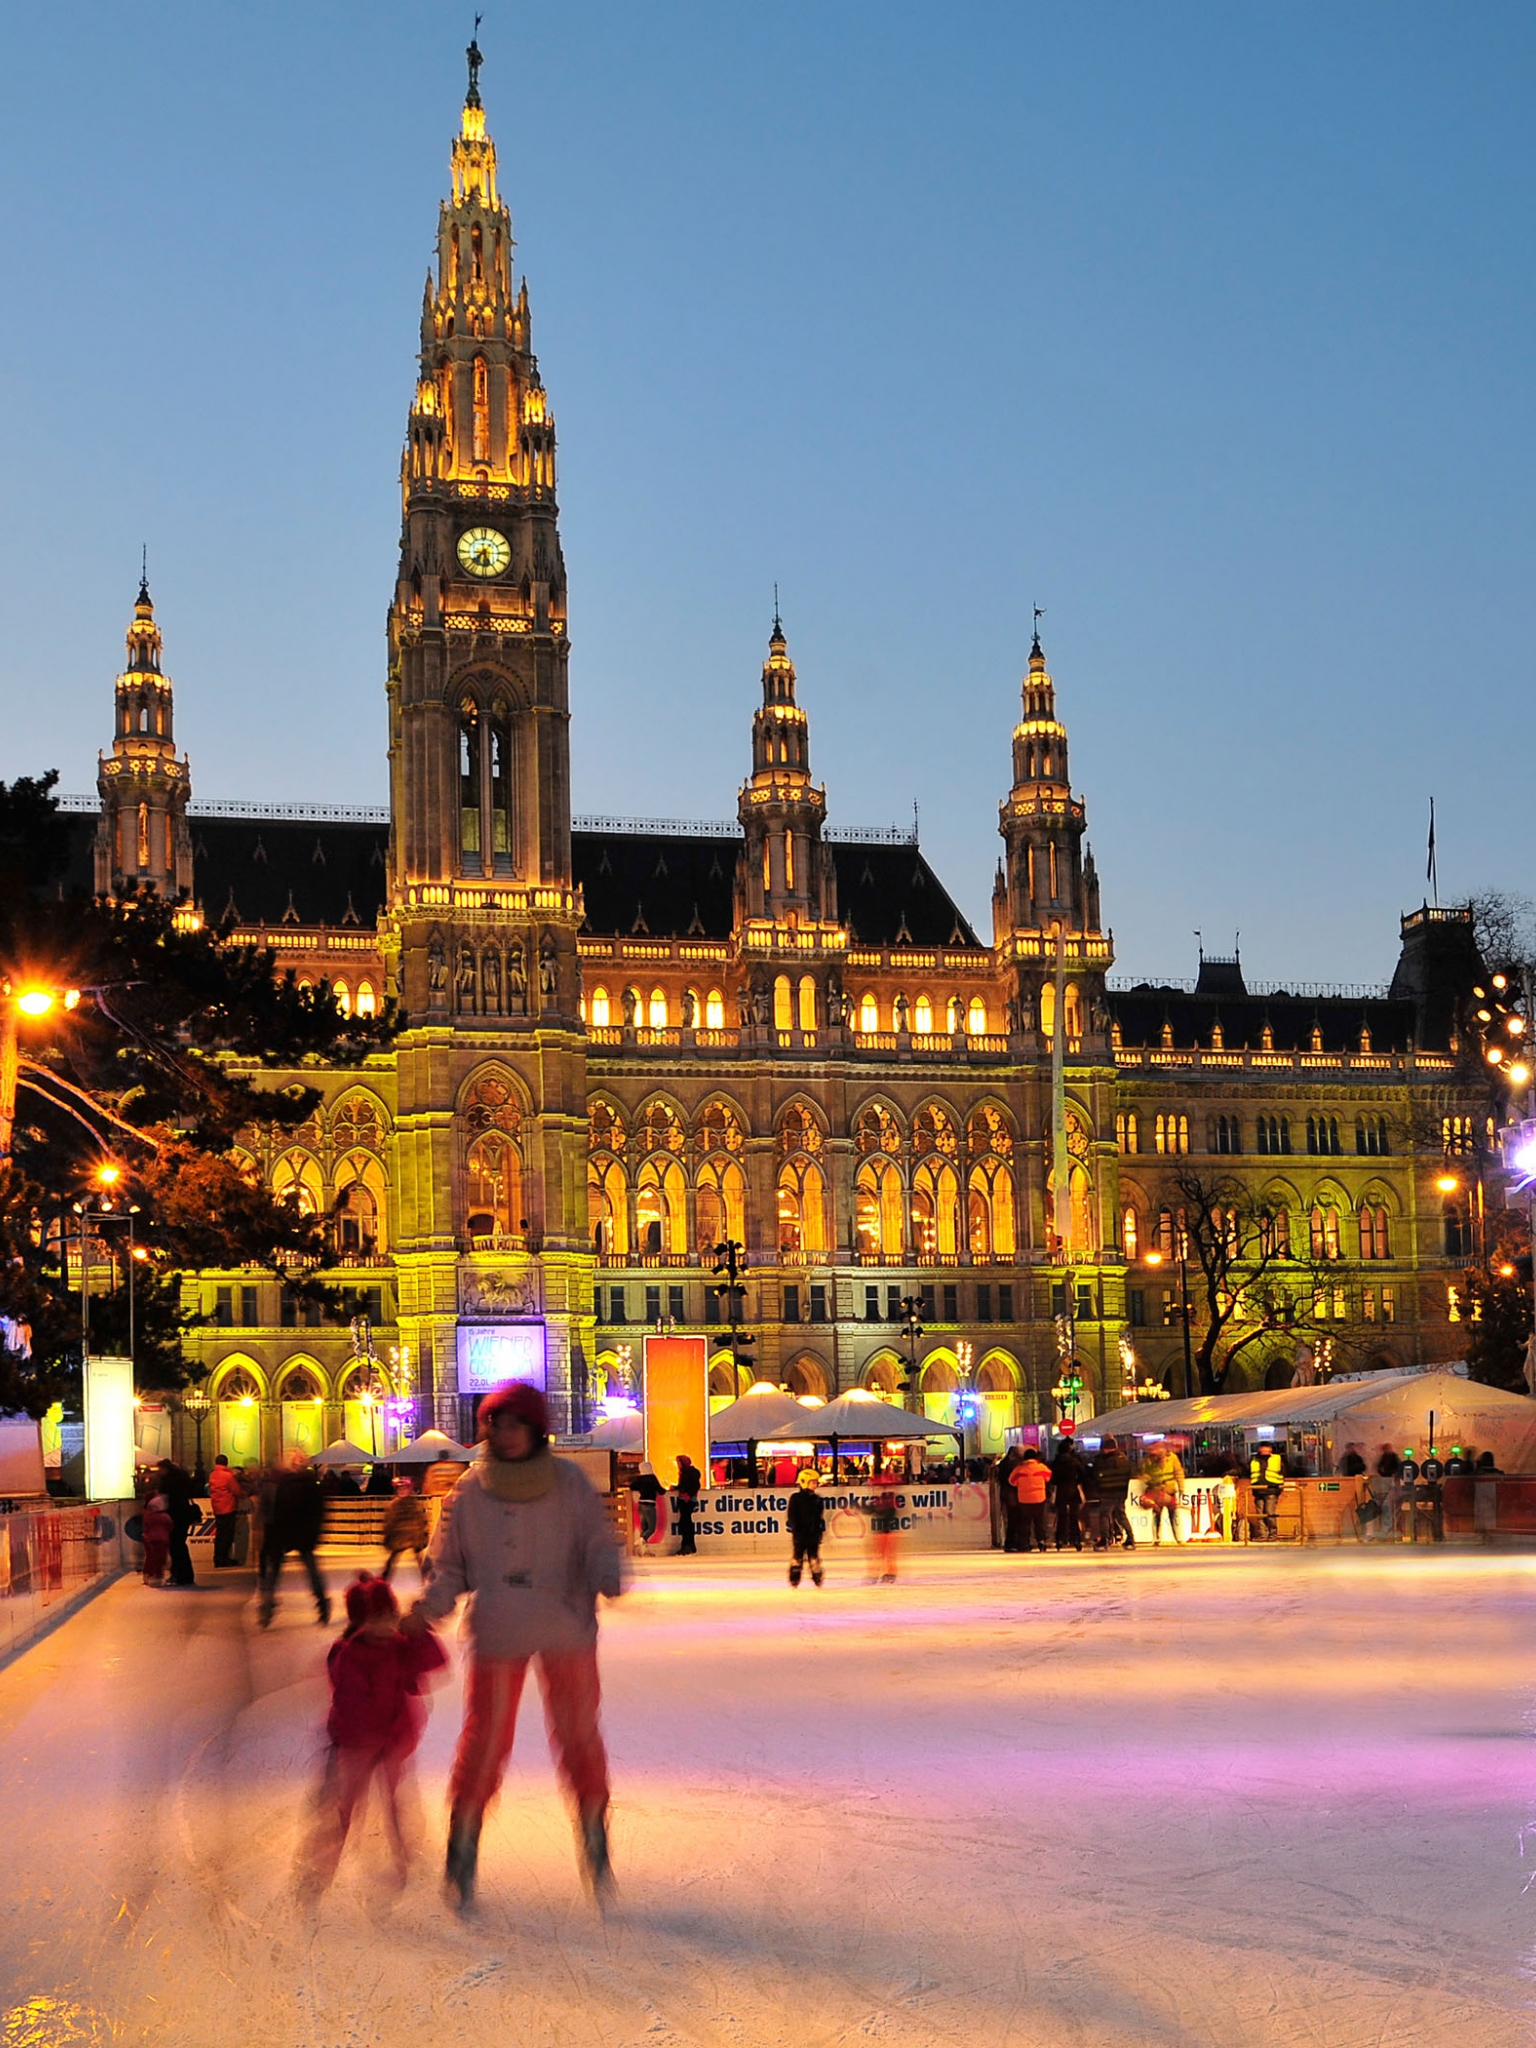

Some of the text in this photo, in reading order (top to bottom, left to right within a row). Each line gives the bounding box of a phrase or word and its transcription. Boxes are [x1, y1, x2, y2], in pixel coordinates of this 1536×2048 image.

[715, 1494, 788, 1513] direkte
[912, 1490, 953, 1510] will,
[731, 1516, 779, 1534] auch
[1131, 1516, 1149, 1527] no
